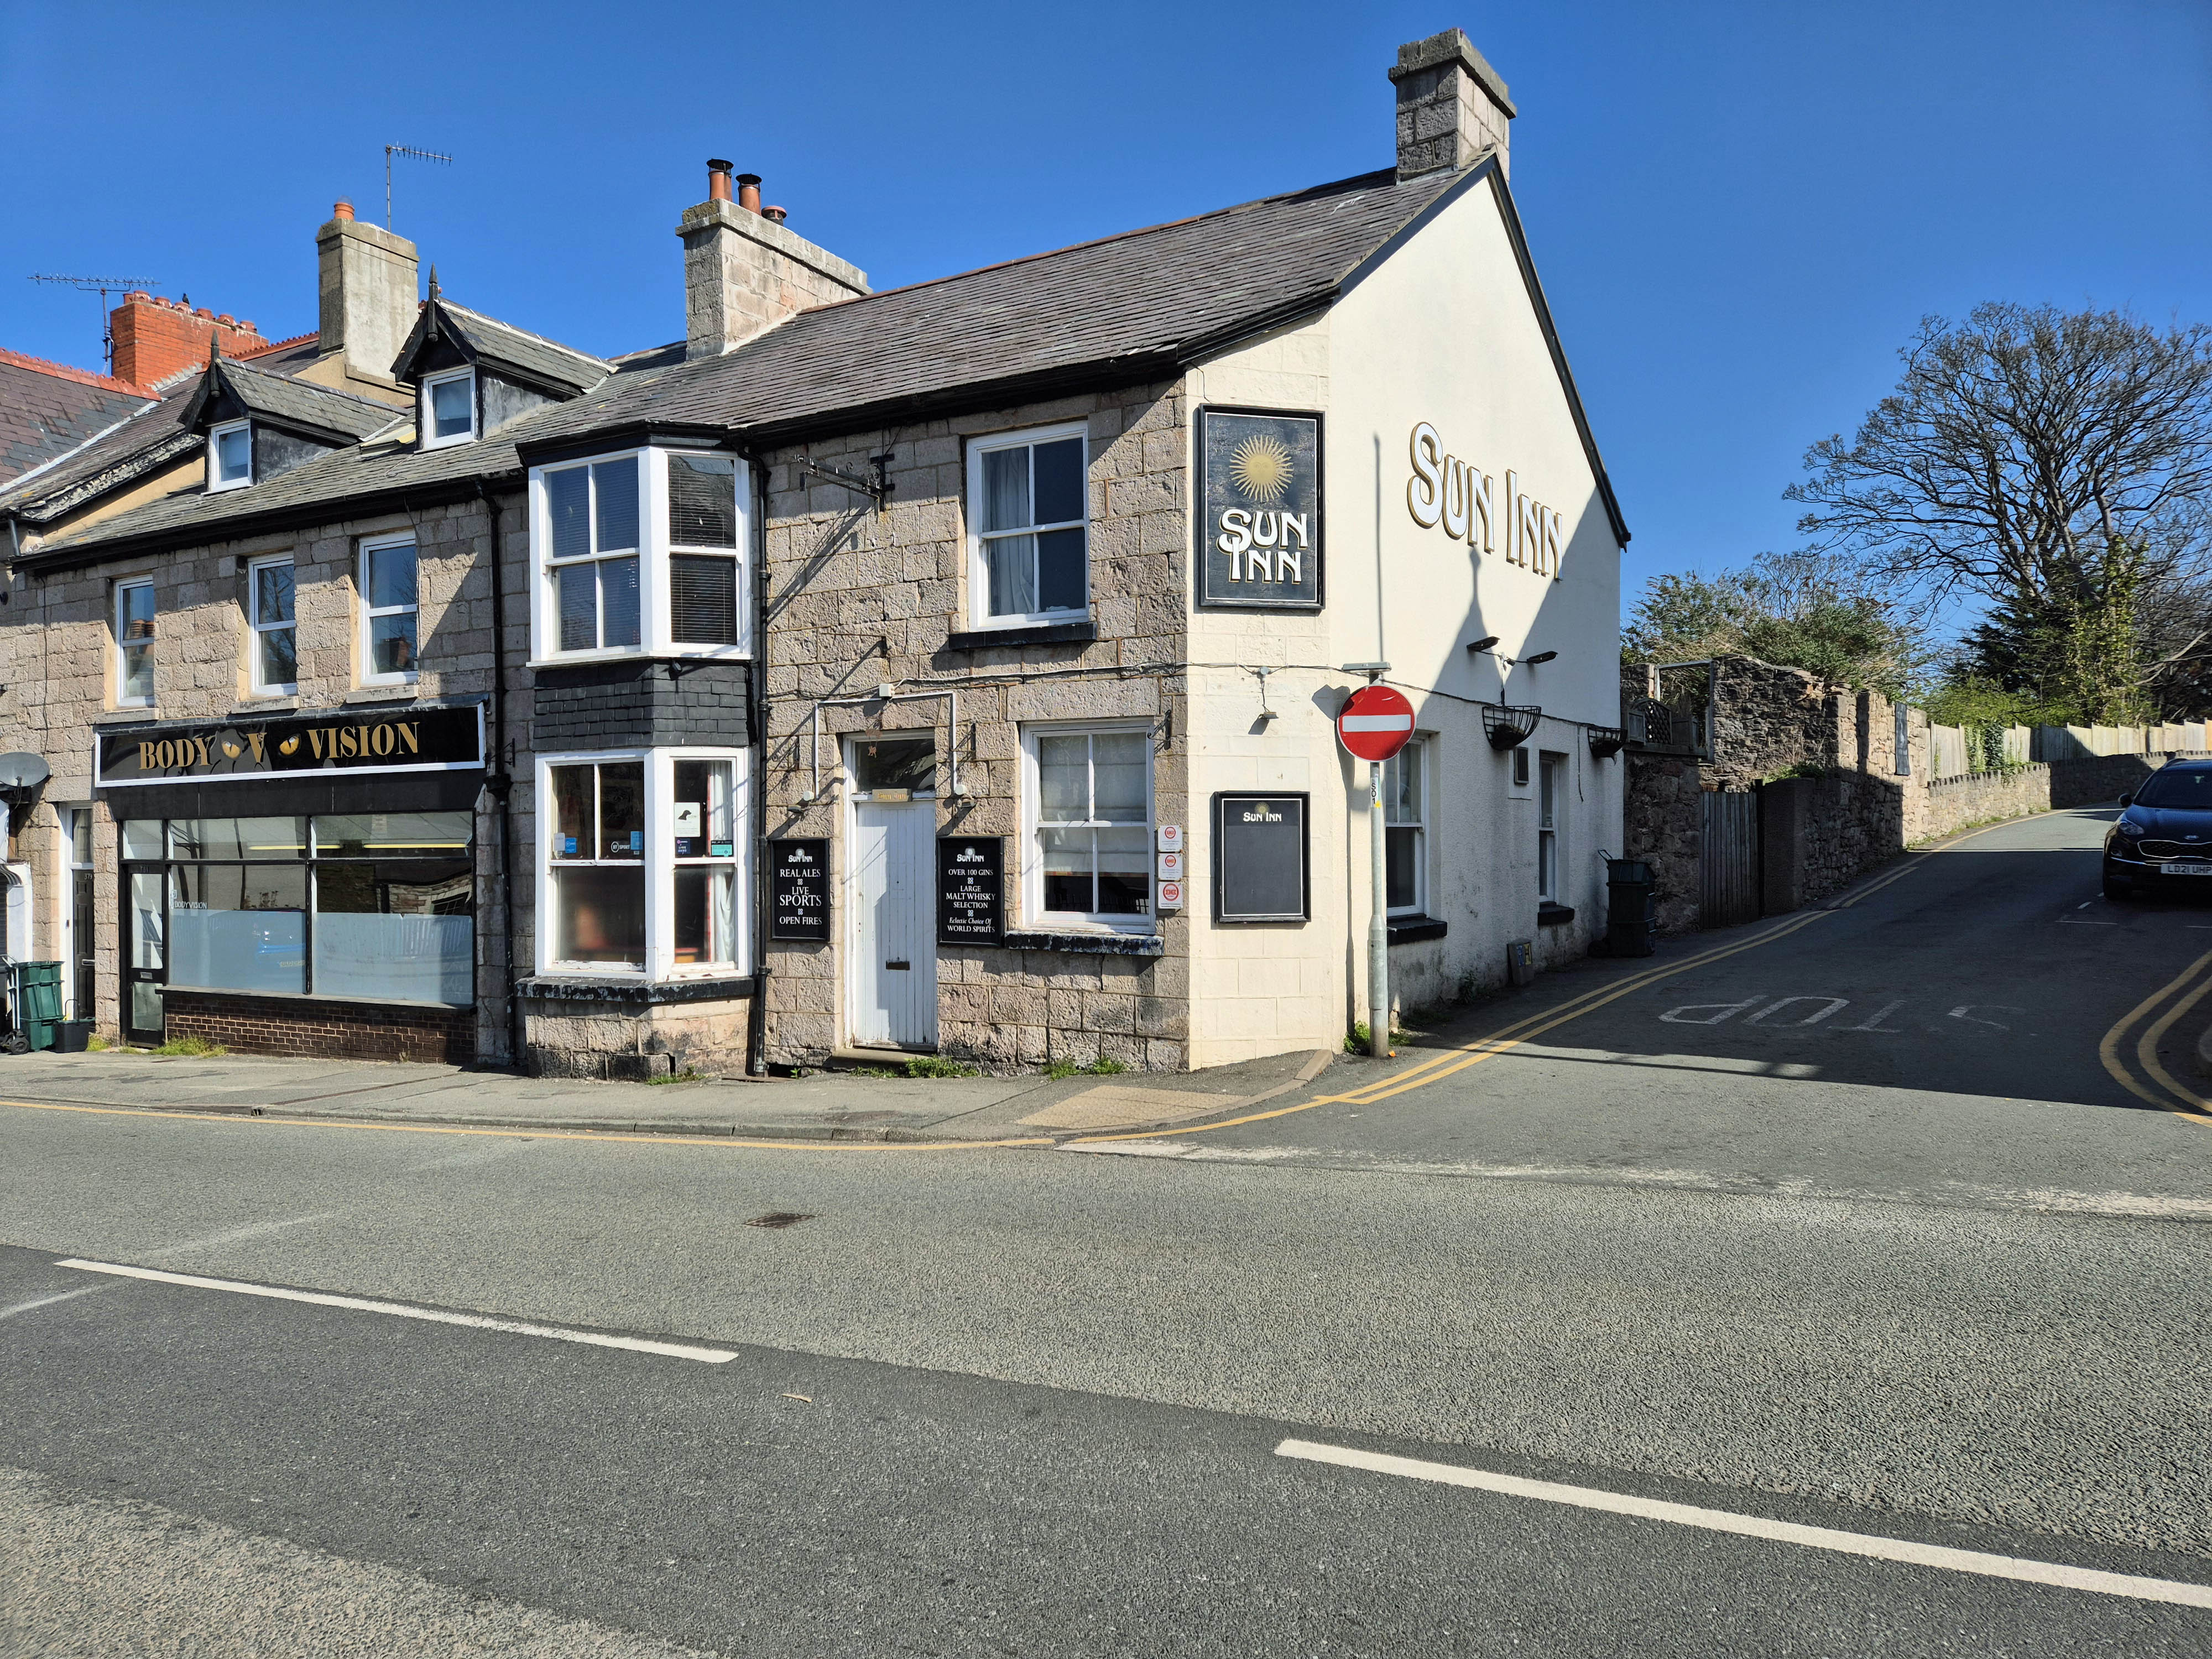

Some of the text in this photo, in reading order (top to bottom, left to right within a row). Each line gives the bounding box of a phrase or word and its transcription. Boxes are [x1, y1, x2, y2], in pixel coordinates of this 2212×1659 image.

[1407, 422, 1563, 583] SUN INN
[1217, 509, 1308, 555] SUN
[1229, 537, 1301, 585] INN
[139, 737, 213, 770] BODY
[306, 722, 420, 759] VISION
[1243, 812, 1282, 822] SUN INN
[957, 854, 984, 862] SUN INN
[780, 869, 821, 878] REAL ALES
[792, 886, 810, 895] LIVE
[780, 894, 822, 906] SPORTS
[779, 916, 822, 925] OPEN FIRES
[985, 918, 993, 926] Of
